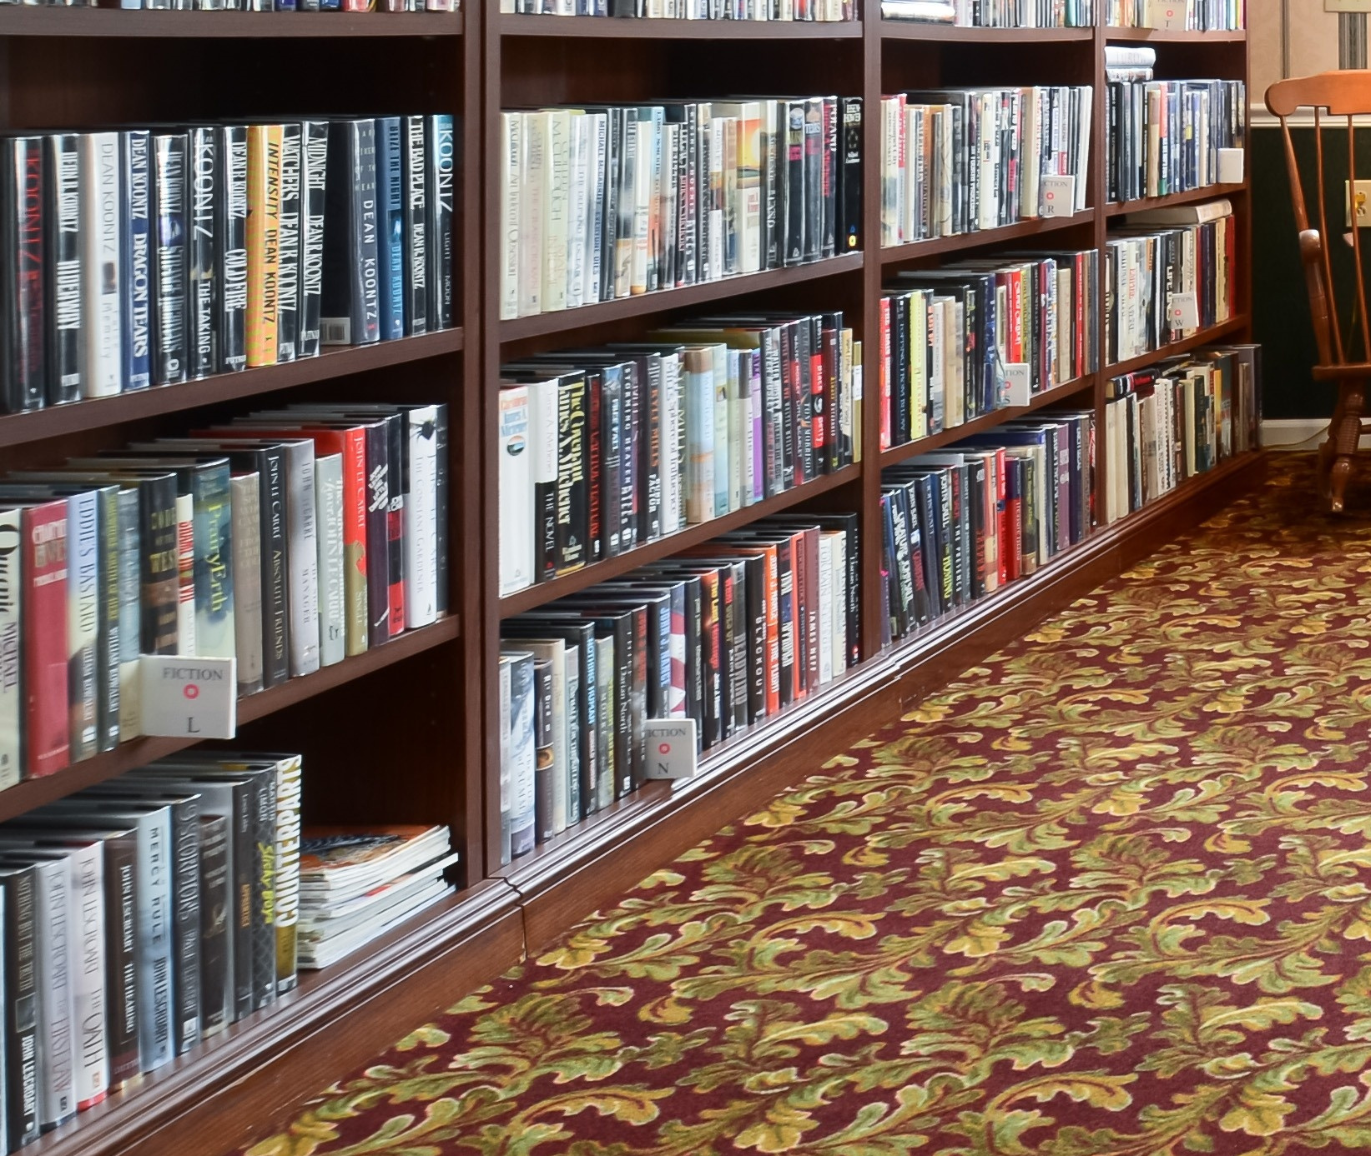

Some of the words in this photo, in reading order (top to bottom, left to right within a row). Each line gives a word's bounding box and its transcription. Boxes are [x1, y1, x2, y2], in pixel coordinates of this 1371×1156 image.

[131, 138, 149, 169] DEAN
[228, 141, 248, 169] DEAN
[409, 122, 425, 147] THE
[59, 152, 79, 179] DEAN
[101, 143, 114, 185] DEAN
[266, 142, 280, 220] INTENSITY
[280, 133, 301, 202] WATCHERS
[307, 136, 328, 191] MIDNIGHT
[409, 147, 425, 173] BAD
[439, 129, 454, 214] KOONTZ
[131, 172, 149, 220] KOONTZ
[193, 143, 214, 241] KOONTZ
[228, 180, 248, 220] KOONTZ
[409, 173, 425, 211] PLACE
[1042, 180, 1068, 188] CTION
[17, 148, 41, 264] KOONTZ
[59, 192, 79, 233] KOONTZ
[103, 191, 116, 254] KOONTZ
[363, 199, 375, 245] DEAN
[1047, 204, 1055, 214] R
[264, 228, 277, 265] DEAN
[279, 211, 300, 248] DEAN
[305, 214, 325, 244] DEAN
[133, 232, 148, 303] DRAGON
[224, 248, 248, 282] COLD
[303, 253, 322, 297] KOONTZ
[413, 256, 426, 290] KOONTZ
[198, 281, 211, 305] THE
[224, 282, 248, 313] FIRE
[262, 271, 276, 325] KOONTZ
[277, 263, 298, 314] KOONTZ
[363, 258, 377, 320] KOONTZ
[392, 276, 404, 315] KOONTZ
[133, 304, 148, 358] TEARS
[198, 308, 211, 354] TAKING
[1174, 319, 1184, 328] W
[571, 381, 586, 411] The
[624, 366, 632, 431] STORMING
[899, 367, 907, 396] FROM
[611, 398, 620, 425] FREE
[651, 388, 660, 424] KYLE
[899, 397, 907, 432] BELOW
[571, 411, 585, 484] Covenant
[624, 437, 632, 487] HEAVEN
[651, 428, 660, 468] MILLS
[267, 455, 280, 485] JOHN
[669, 456, 679, 515] Influence
[940, 474, 949, 504] JOHN
[415, 477, 424, 535] CONSTANT
[544, 491, 555, 513] THE
[648, 473, 658, 514] FACTOR
[78, 498, 97, 559] EDDIE'S
[544, 516, 555, 552] NOVEL
[941, 503, 951, 529] SAUL
[205, 502, 228, 613] PrairyErth
[273, 549, 283, 606] ABSOLUTE
[415, 537, 424, 595] GARDENER
[941, 555, 953, 600] HOMING
[78, 562, 97, 633] BASTARD
[301, 568, 312, 625] MANAGER
[274, 609, 285, 661] FRIENDS
[781, 620, 793, 668] APPROACH
[809, 611, 817, 644] JAMES
[3, 621, 19, 694] MICHAEL
[162, 666, 224, 682] FICTION
[659, 649, 670, 689] NANCE
[734, 632, 748, 706] HEADWIND
[755, 615, 763, 697] BLACKOUT
[187, 716, 201, 734] L
[657, 762, 670, 775] N
[149, 826, 161, 888] MERCY
[275, 753, 303, 928] COUNTERPARTS
[47, 869, 67, 911] JOHN
[79, 857, 99, 897] JOHN
[119, 864, 135, 895] JOHN
[178, 823, 199, 921] SCORPIONS
[17, 874, 35, 921] NOTHING
[82, 898, 100, 975] LESCROART
[151, 897, 163, 945] RULE
[50, 912, 68, 992] LESCROART
[152, 956, 167, 987] JOHN
[17, 960, 35, 993] TRUTH
[123, 984, 136, 1035] HEARING
[153, 985, 169, 1045] LESCROART
[20, 1033, 36, 1062] JOHN
[51, 1015, 71, 1057] FIRST
[82, 1009, 105, 1070] OATH
[20, 1061, 36, 1117] LESCROART
[52, 1055, 72, 1093] LAW
